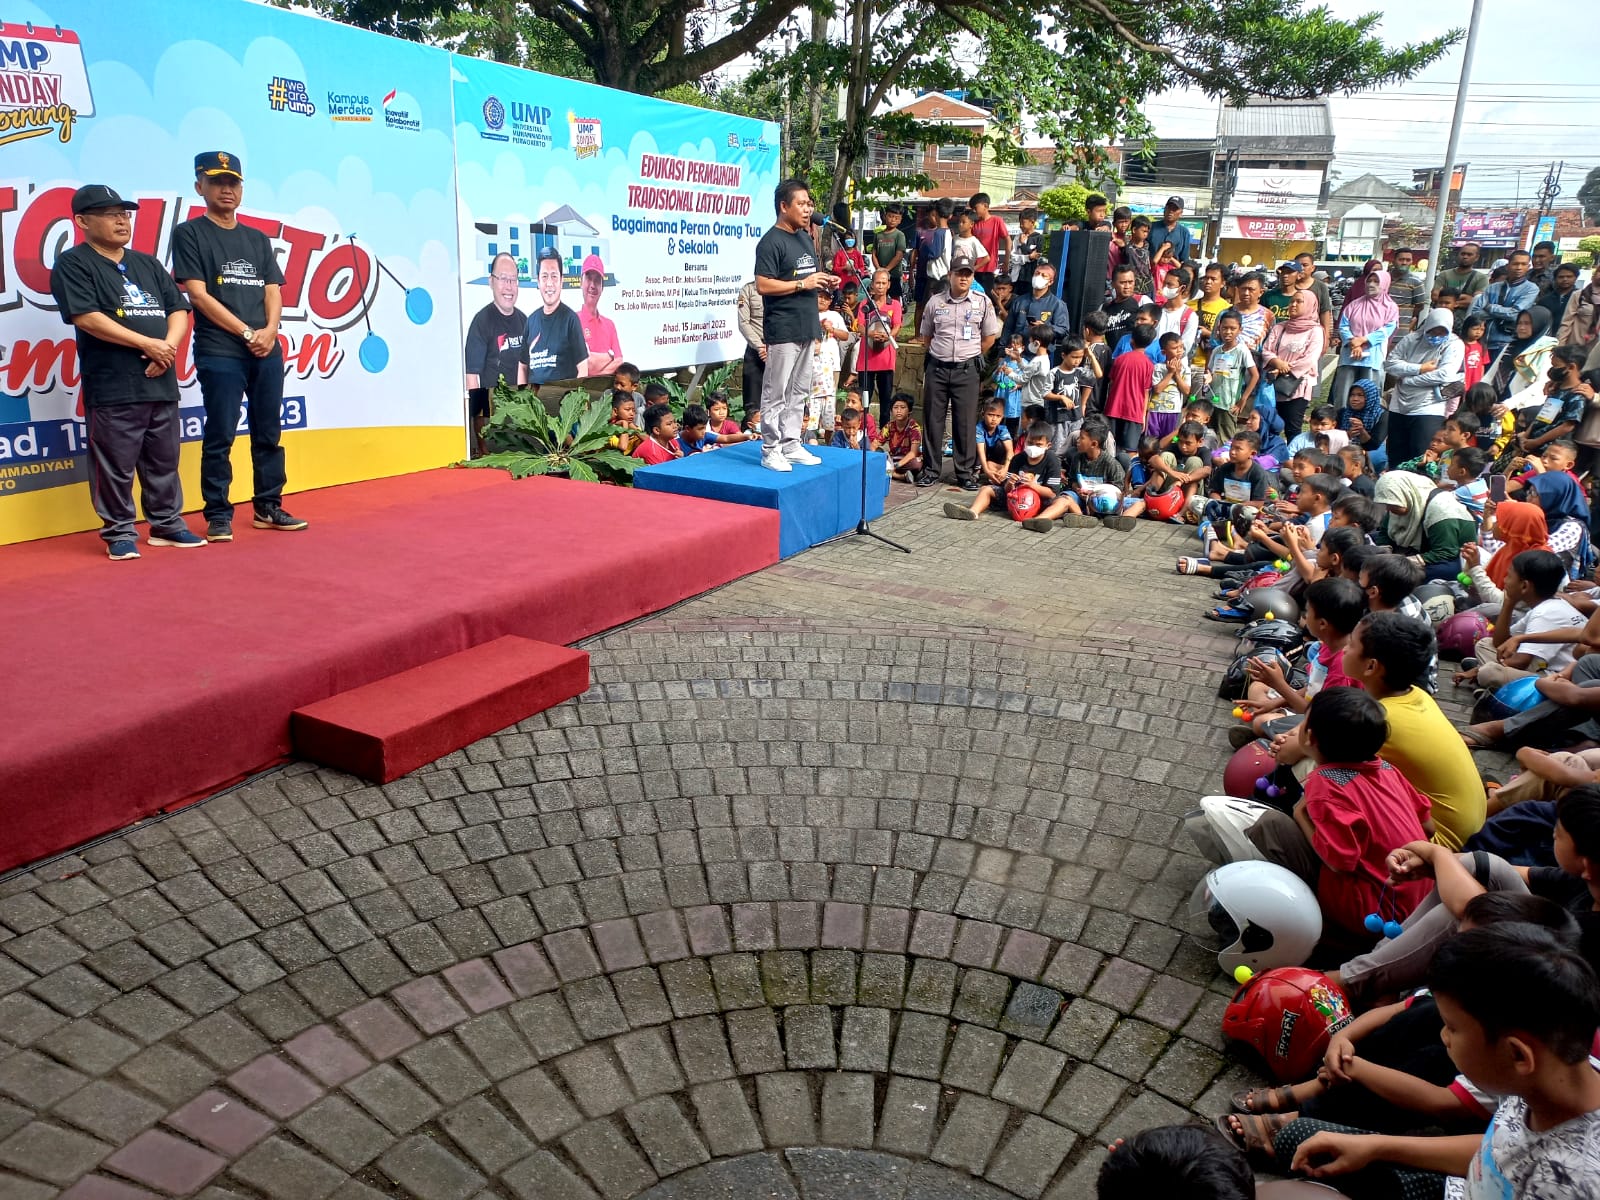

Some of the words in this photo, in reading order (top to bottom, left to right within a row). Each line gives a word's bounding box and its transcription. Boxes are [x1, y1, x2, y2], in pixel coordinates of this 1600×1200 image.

[327, 91, 369, 105] Kampus
[288, 102, 315, 116] ump
[328, 104, 373, 116] Merdeka
[511, 101, 551, 125] UMP
[385, 116, 420, 127] Kolaboratif
[577, 124, 594, 133] UMP
[641, 155, 685, 181] EDUKASI
[687, 160, 741, 187] PERMAINAN
[628, 185, 694, 212] TRADISIONAL
[695, 191, 723, 215] LATTO
[724, 194, 751, 217] LATTO
[612, 214, 677, 235] Bagaimana
[680, 219, 710, 236] Peran
[713, 221, 743, 239] Orang
[744, 223, 761, 238] Tua
[667, 237, 676, 256] &
[678, 239, 719, 255] Sekolah
[684, 262, 708, 272] Bersama
[684, 288, 699, 296] Ketua
[626, 302, 640, 310] Joko
[678, 300, 695, 309] Kepala
[682, 322, 689, 331] 15
[689, 321, 711, 331] Januari
[711, 320, 726, 329] 2023
[654, 335, 681, 345] Halaman
[681, 334, 702, 343] Kantor
[702, 331, 719, 341] Pusat
[719, 330, 733, 339] UMP
